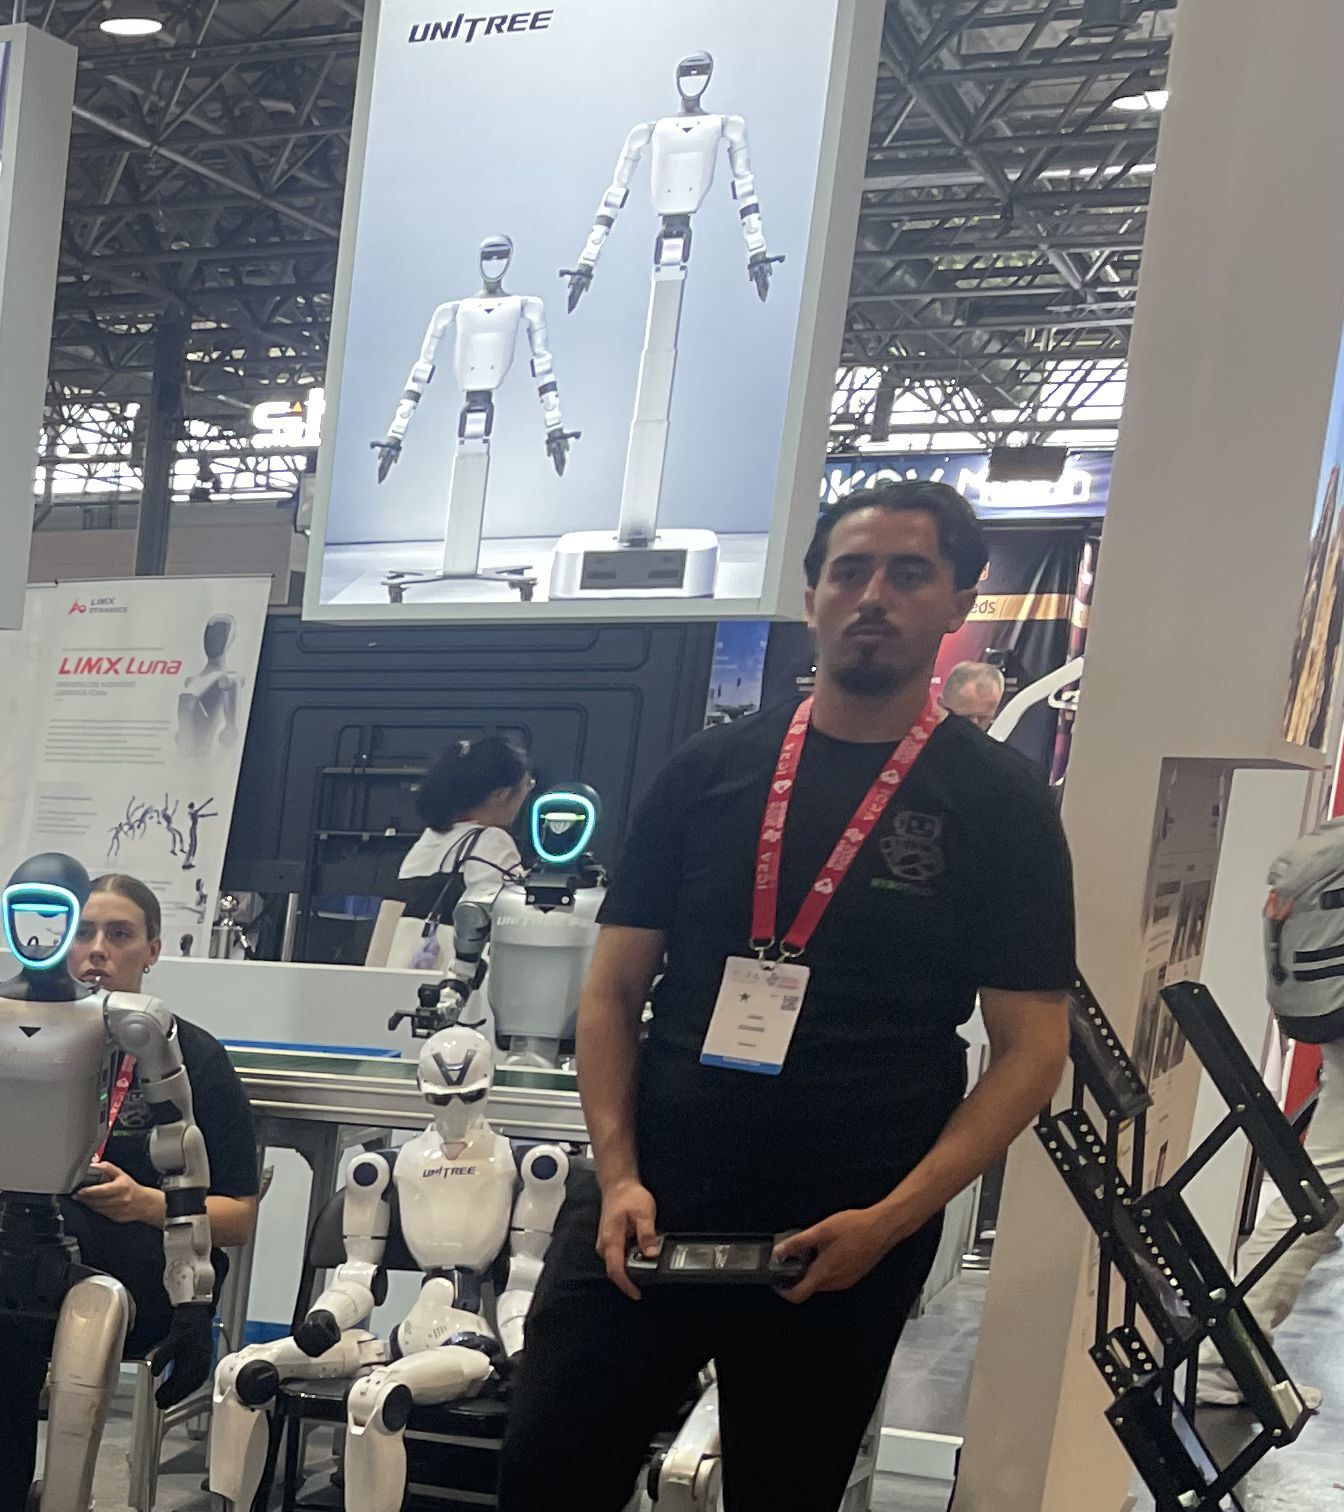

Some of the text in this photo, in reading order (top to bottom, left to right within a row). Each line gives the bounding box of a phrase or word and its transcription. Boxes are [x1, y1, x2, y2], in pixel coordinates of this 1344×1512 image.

[408, 9, 554, 43] UNITREE
[58, 656, 183, 675] LIMX Luna
[422, 1165, 477, 1179] UNITREE
